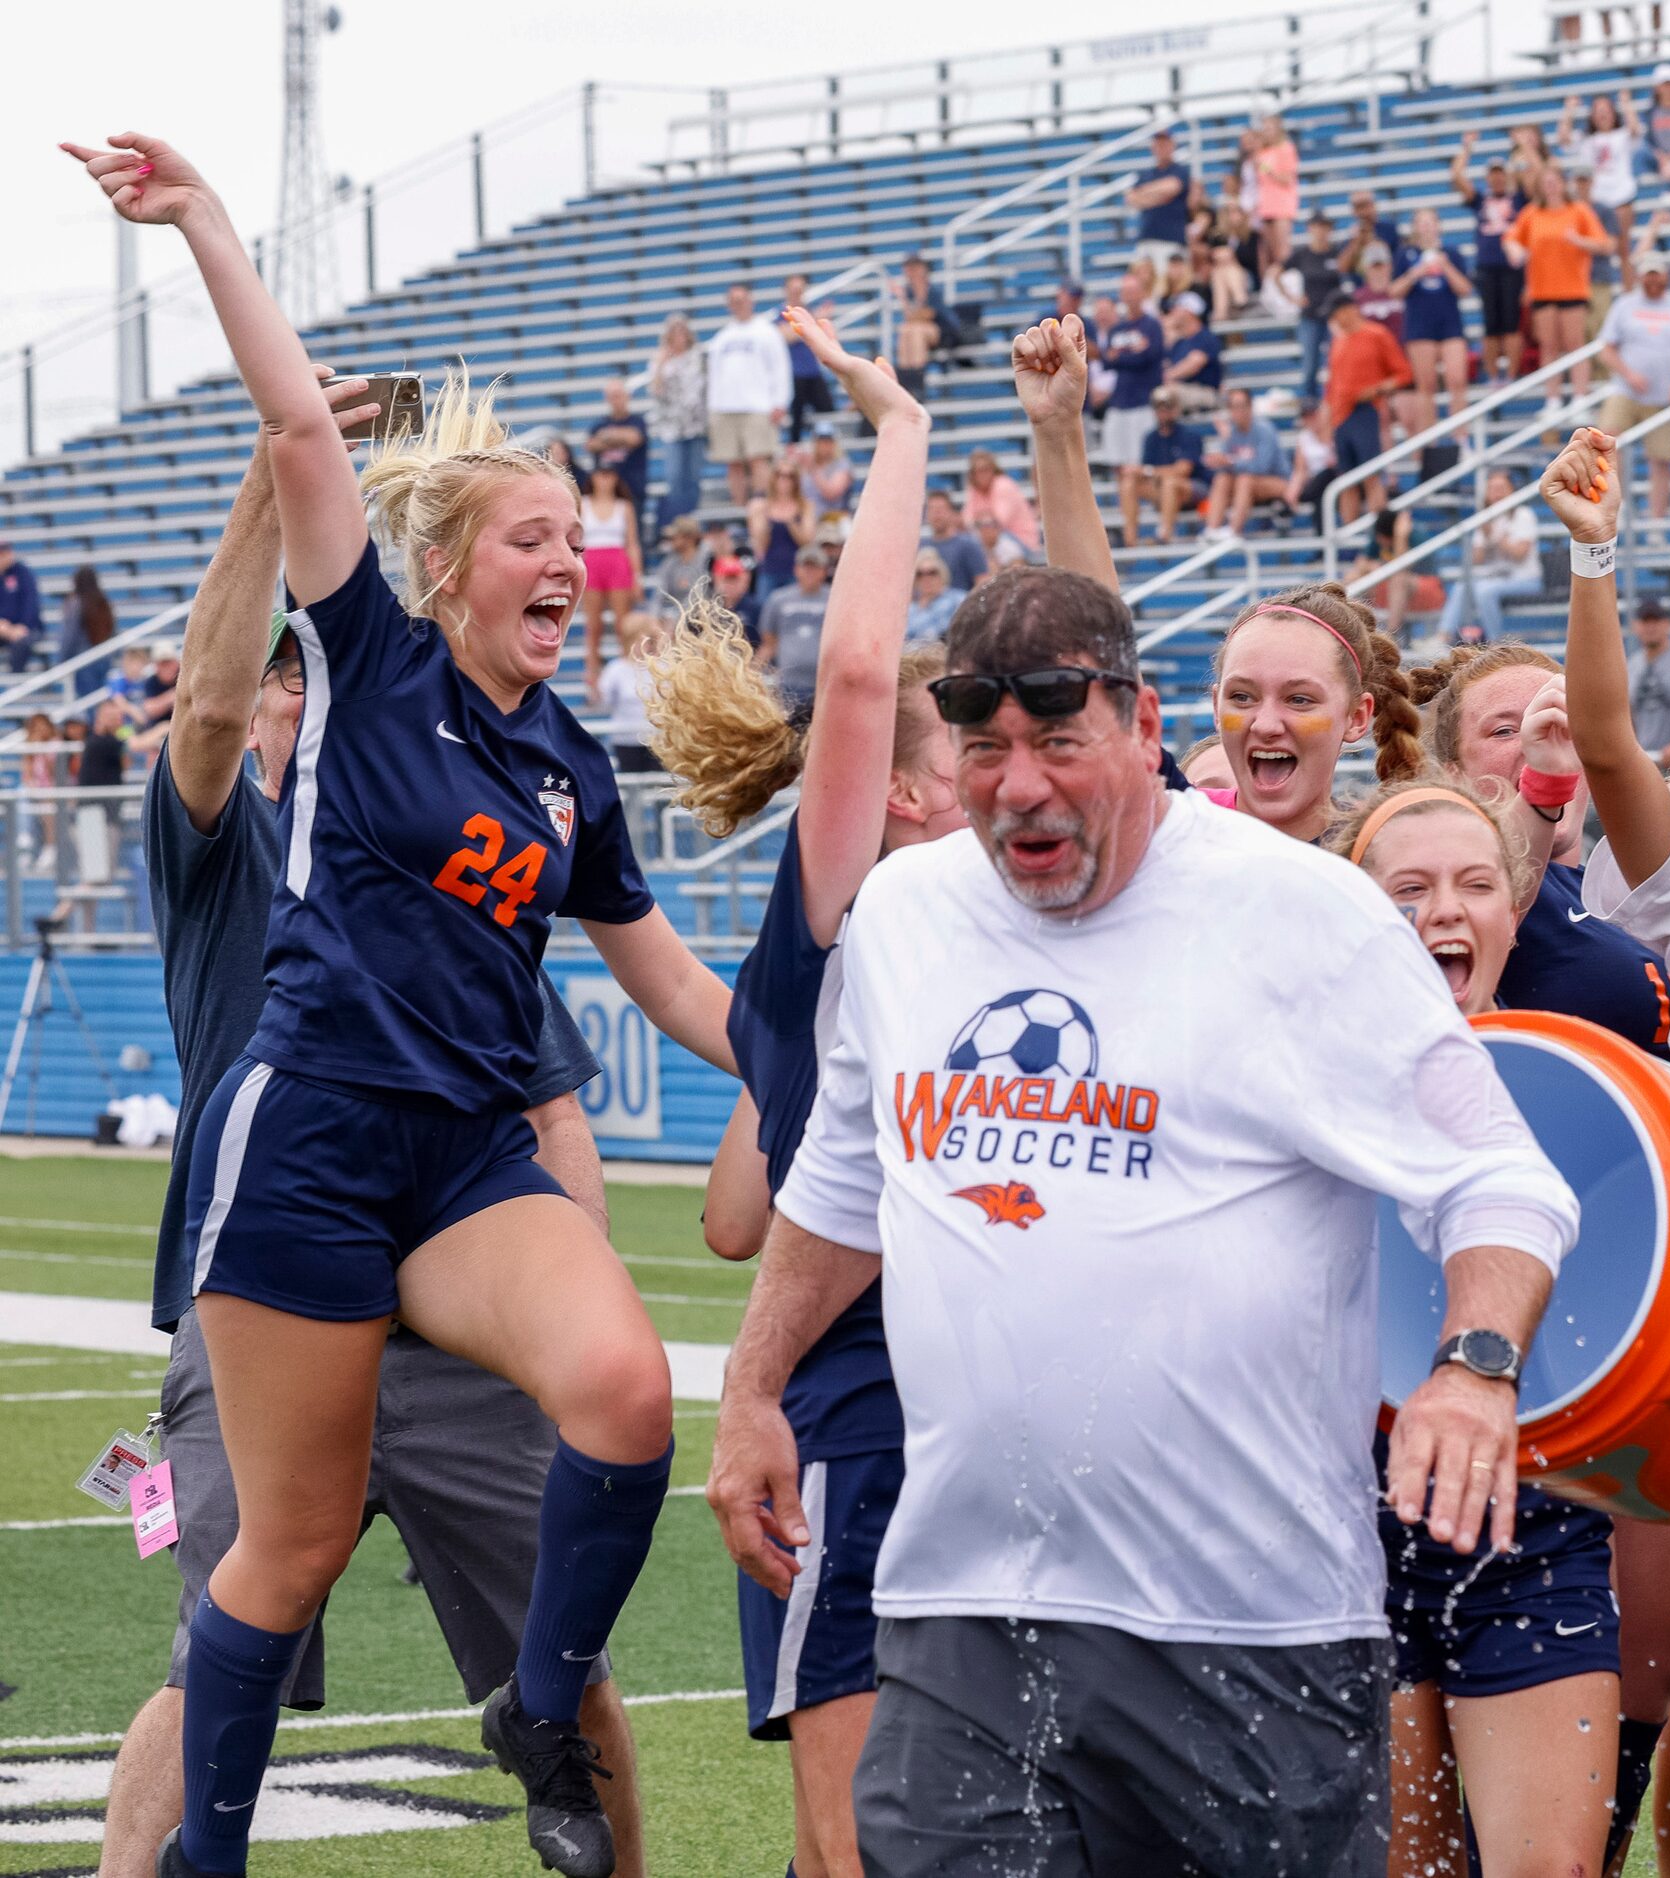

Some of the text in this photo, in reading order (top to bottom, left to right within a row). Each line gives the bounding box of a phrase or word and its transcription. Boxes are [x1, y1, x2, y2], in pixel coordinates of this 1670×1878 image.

[433, 812, 548, 927] 24
[580, 1002, 649, 1117] 30
[895, 1070, 1160, 1163] WAKELAND
[943, 1124, 1155, 1180] SOCCER
[114, 1446, 147, 1468] PRESS
